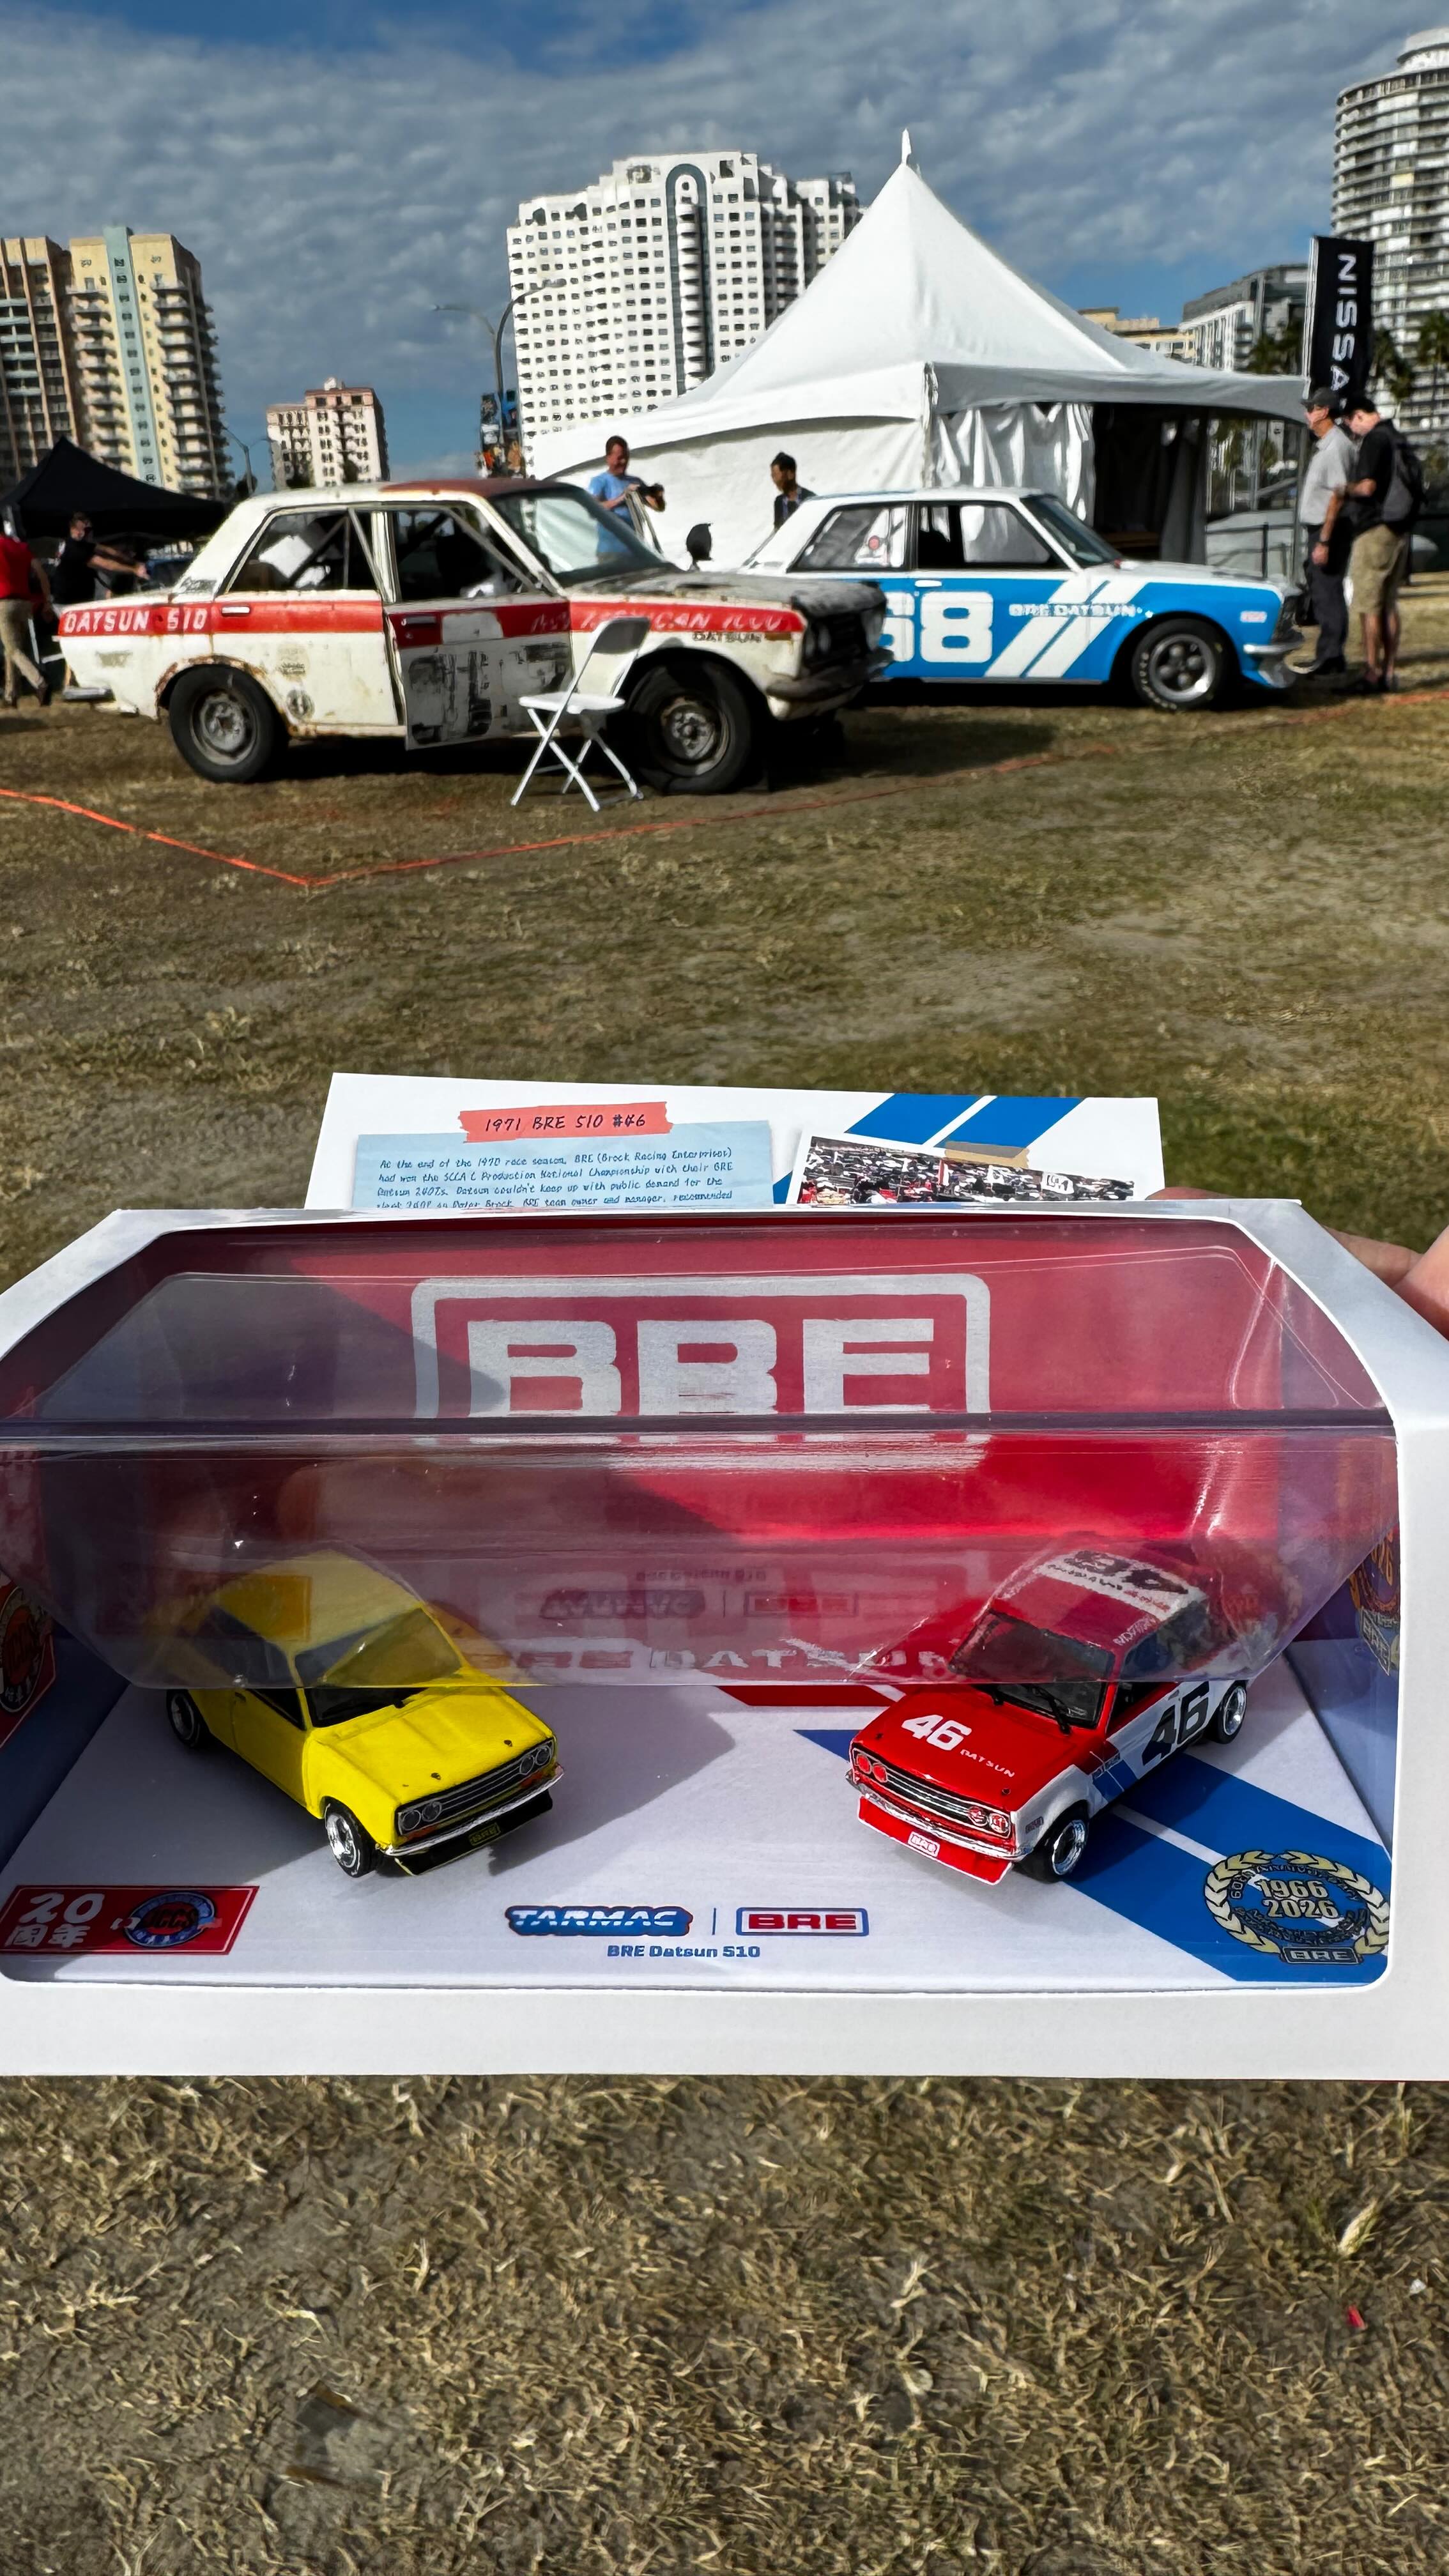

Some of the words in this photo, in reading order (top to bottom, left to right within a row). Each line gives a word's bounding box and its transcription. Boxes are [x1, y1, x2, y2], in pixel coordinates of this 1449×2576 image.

[1330, 253, 1358, 423] NISSA
[64, 610, 151, 634] DATSUN
[166, 606, 208, 631] 510
[485, 1117, 521, 1131] 1971
[532, 1115, 566, 1130] BRE
[575, 1114, 604, 1128] 510
[612, 1114, 646, 1128] #46
[397, 1160, 412, 1169] the
[417, 1160, 435, 1169] end
[439, 1158, 450, 1168] of
[456, 1158, 471, 1168] the
[478, 1157, 501, 1167] 1970
[505, 1157, 527, 1166] race
[574, 1154, 594, 1163] BRE
[597, 1153, 630, 1163] (Brock
[634, 1151, 667, 1161] Racing
[672, 1147, 732, 1159] Enterprises)
[378, 1173, 396, 1183] had
[422, 1173, 438, 1183] the
[481, 1170, 536, 1181] Production
[540, 1168, 583, 1179] National
[588, 1165, 650, 1177] Championship
[654, 1164, 677, 1174] with
[682, 1163, 709, 1173] their
[714, 1162, 733, 1172] BRE
[377, 1187, 410, 1197] Datsun
[456, 1186, 489, 1195] Datsun
[494, 1183, 535, 1195] couldn't
[539, 1184, 563, 1193] keep
[567, 1184, 578, 1193] up
[583, 1181, 606, 1192] with
[610, 1180, 641, 1192] public
[645, 1178, 680, 1188] demand
[684, 1177, 701, 1187] for
[706, 1177, 723, 1186] the
[603, 1195, 620, 1204] and
[468, 1317, 935, 1417] BRE
[901, 1713, 973, 1751] 46
[1141, 1680, 1210, 1767] 46
[960, 1749, 1015, 1778] DATSUN
[1255, 1880, 1329, 1898] 1966
[19, 1891, 105, 1924] 20
[1262, 1899, 1340, 1918] 2026
[511, 1910, 677, 1927] TARMAC
[748, 1913, 857, 1930] BRE
[4, 1924, 91, 1949] 周年
[606, 1945, 645, 1958] BRE
[648, 1945, 718, 1958] Datsun
[723, 1945, 761, 1958] 510
